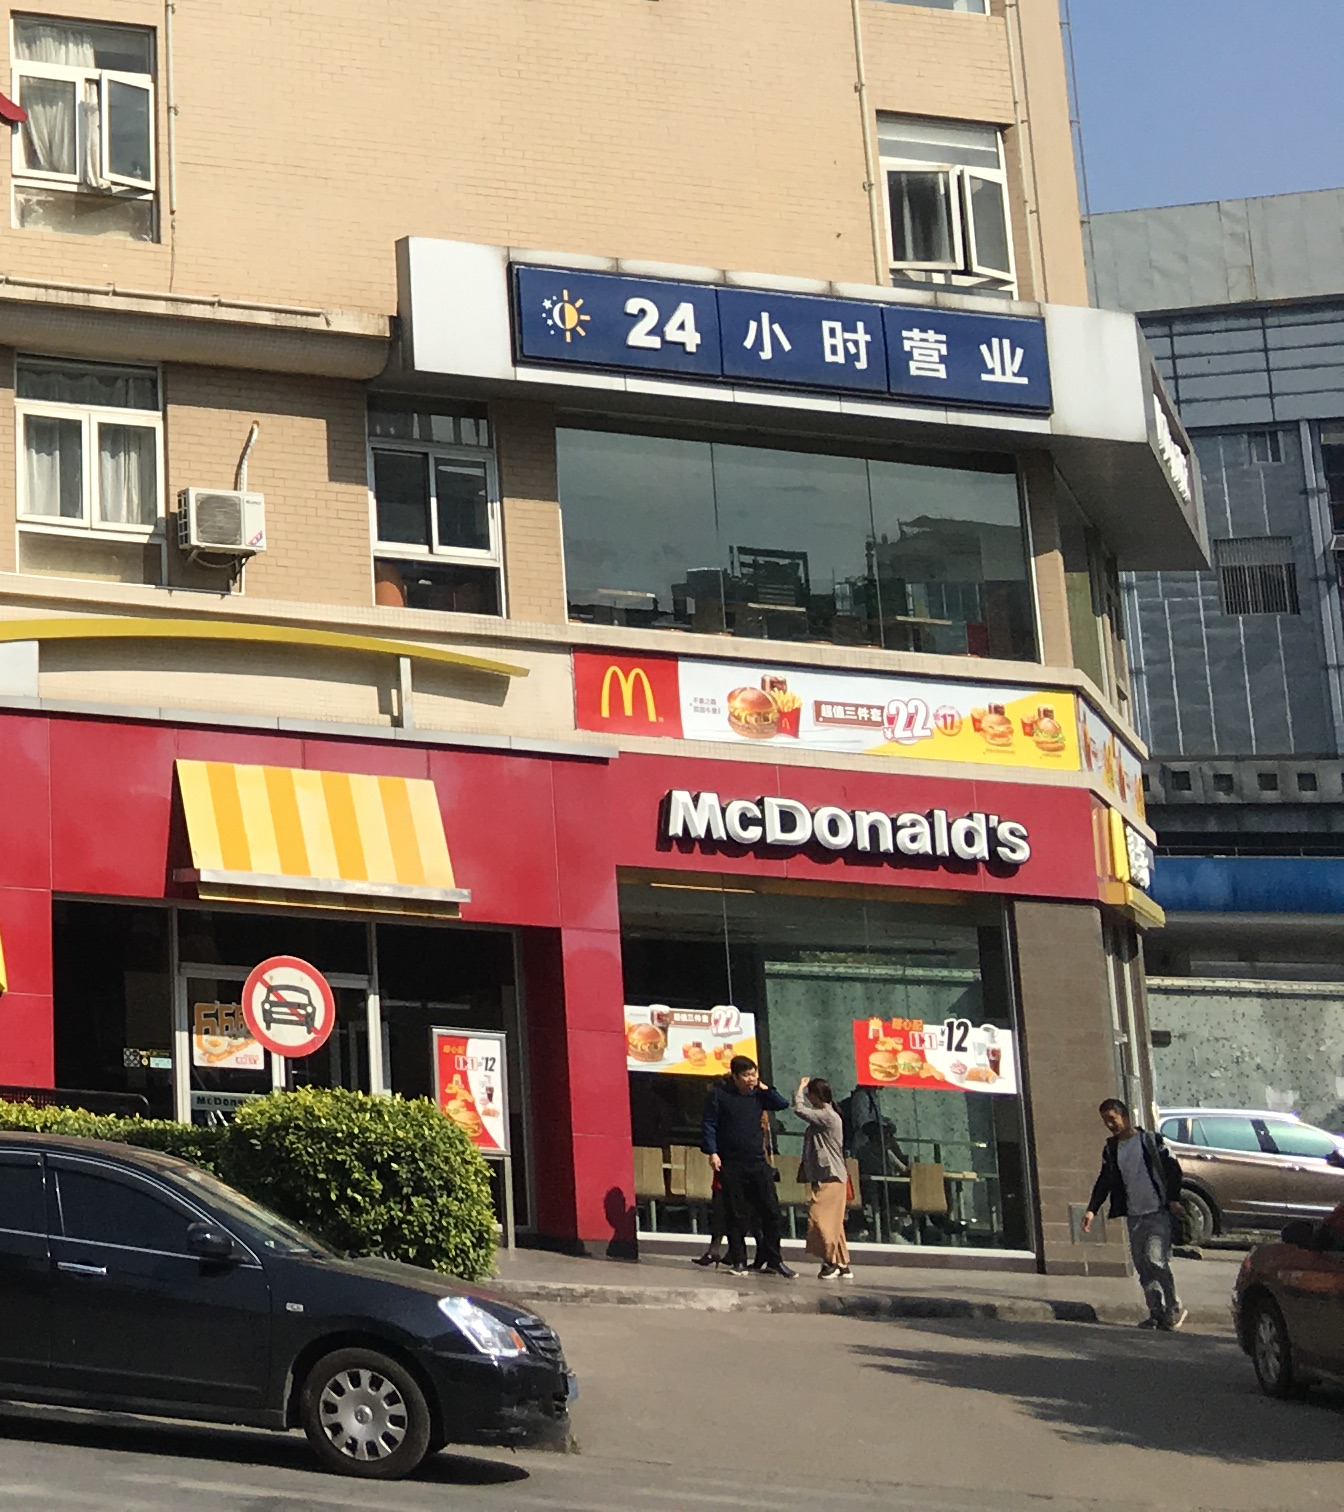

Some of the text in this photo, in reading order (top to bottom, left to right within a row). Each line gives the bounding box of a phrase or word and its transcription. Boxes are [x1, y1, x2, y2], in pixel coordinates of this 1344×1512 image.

[624, 296, 1029, 385] 24小时营业
[668, 790, 1031, 864] McDonald's
